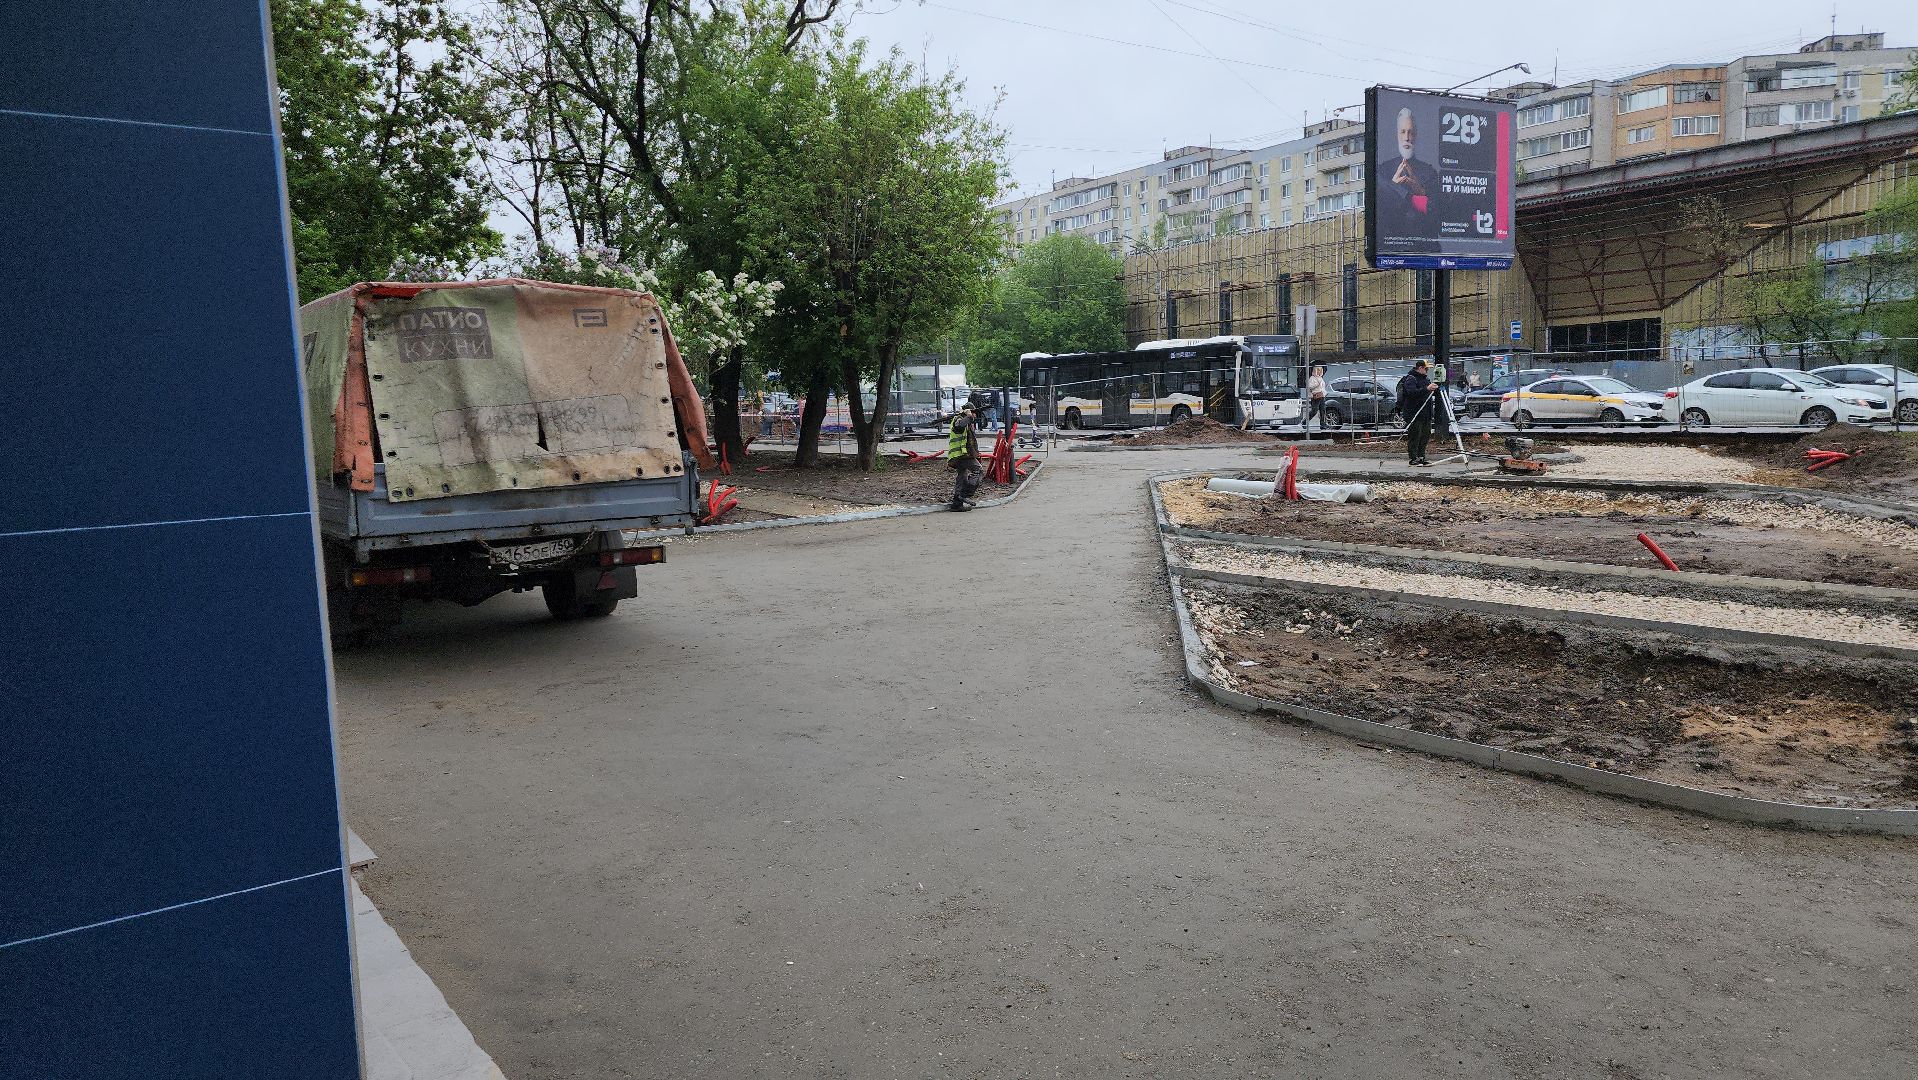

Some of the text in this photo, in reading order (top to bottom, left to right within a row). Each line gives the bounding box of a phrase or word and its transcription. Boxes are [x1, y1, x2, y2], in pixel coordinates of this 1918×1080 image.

[1442, 112, 1488, 145] 28%
[1442, 175, 1488, 186] НА ОСТАТКИ
[1442, 184, 1487, 195] ГБ И МИНУТ
[1473, 209, 1494, 234] t2
[399, 311, 483, 330] ПАТИО
[404, 338, 488, 358] КУХНИ
[551, 539, 572, 552] 750
